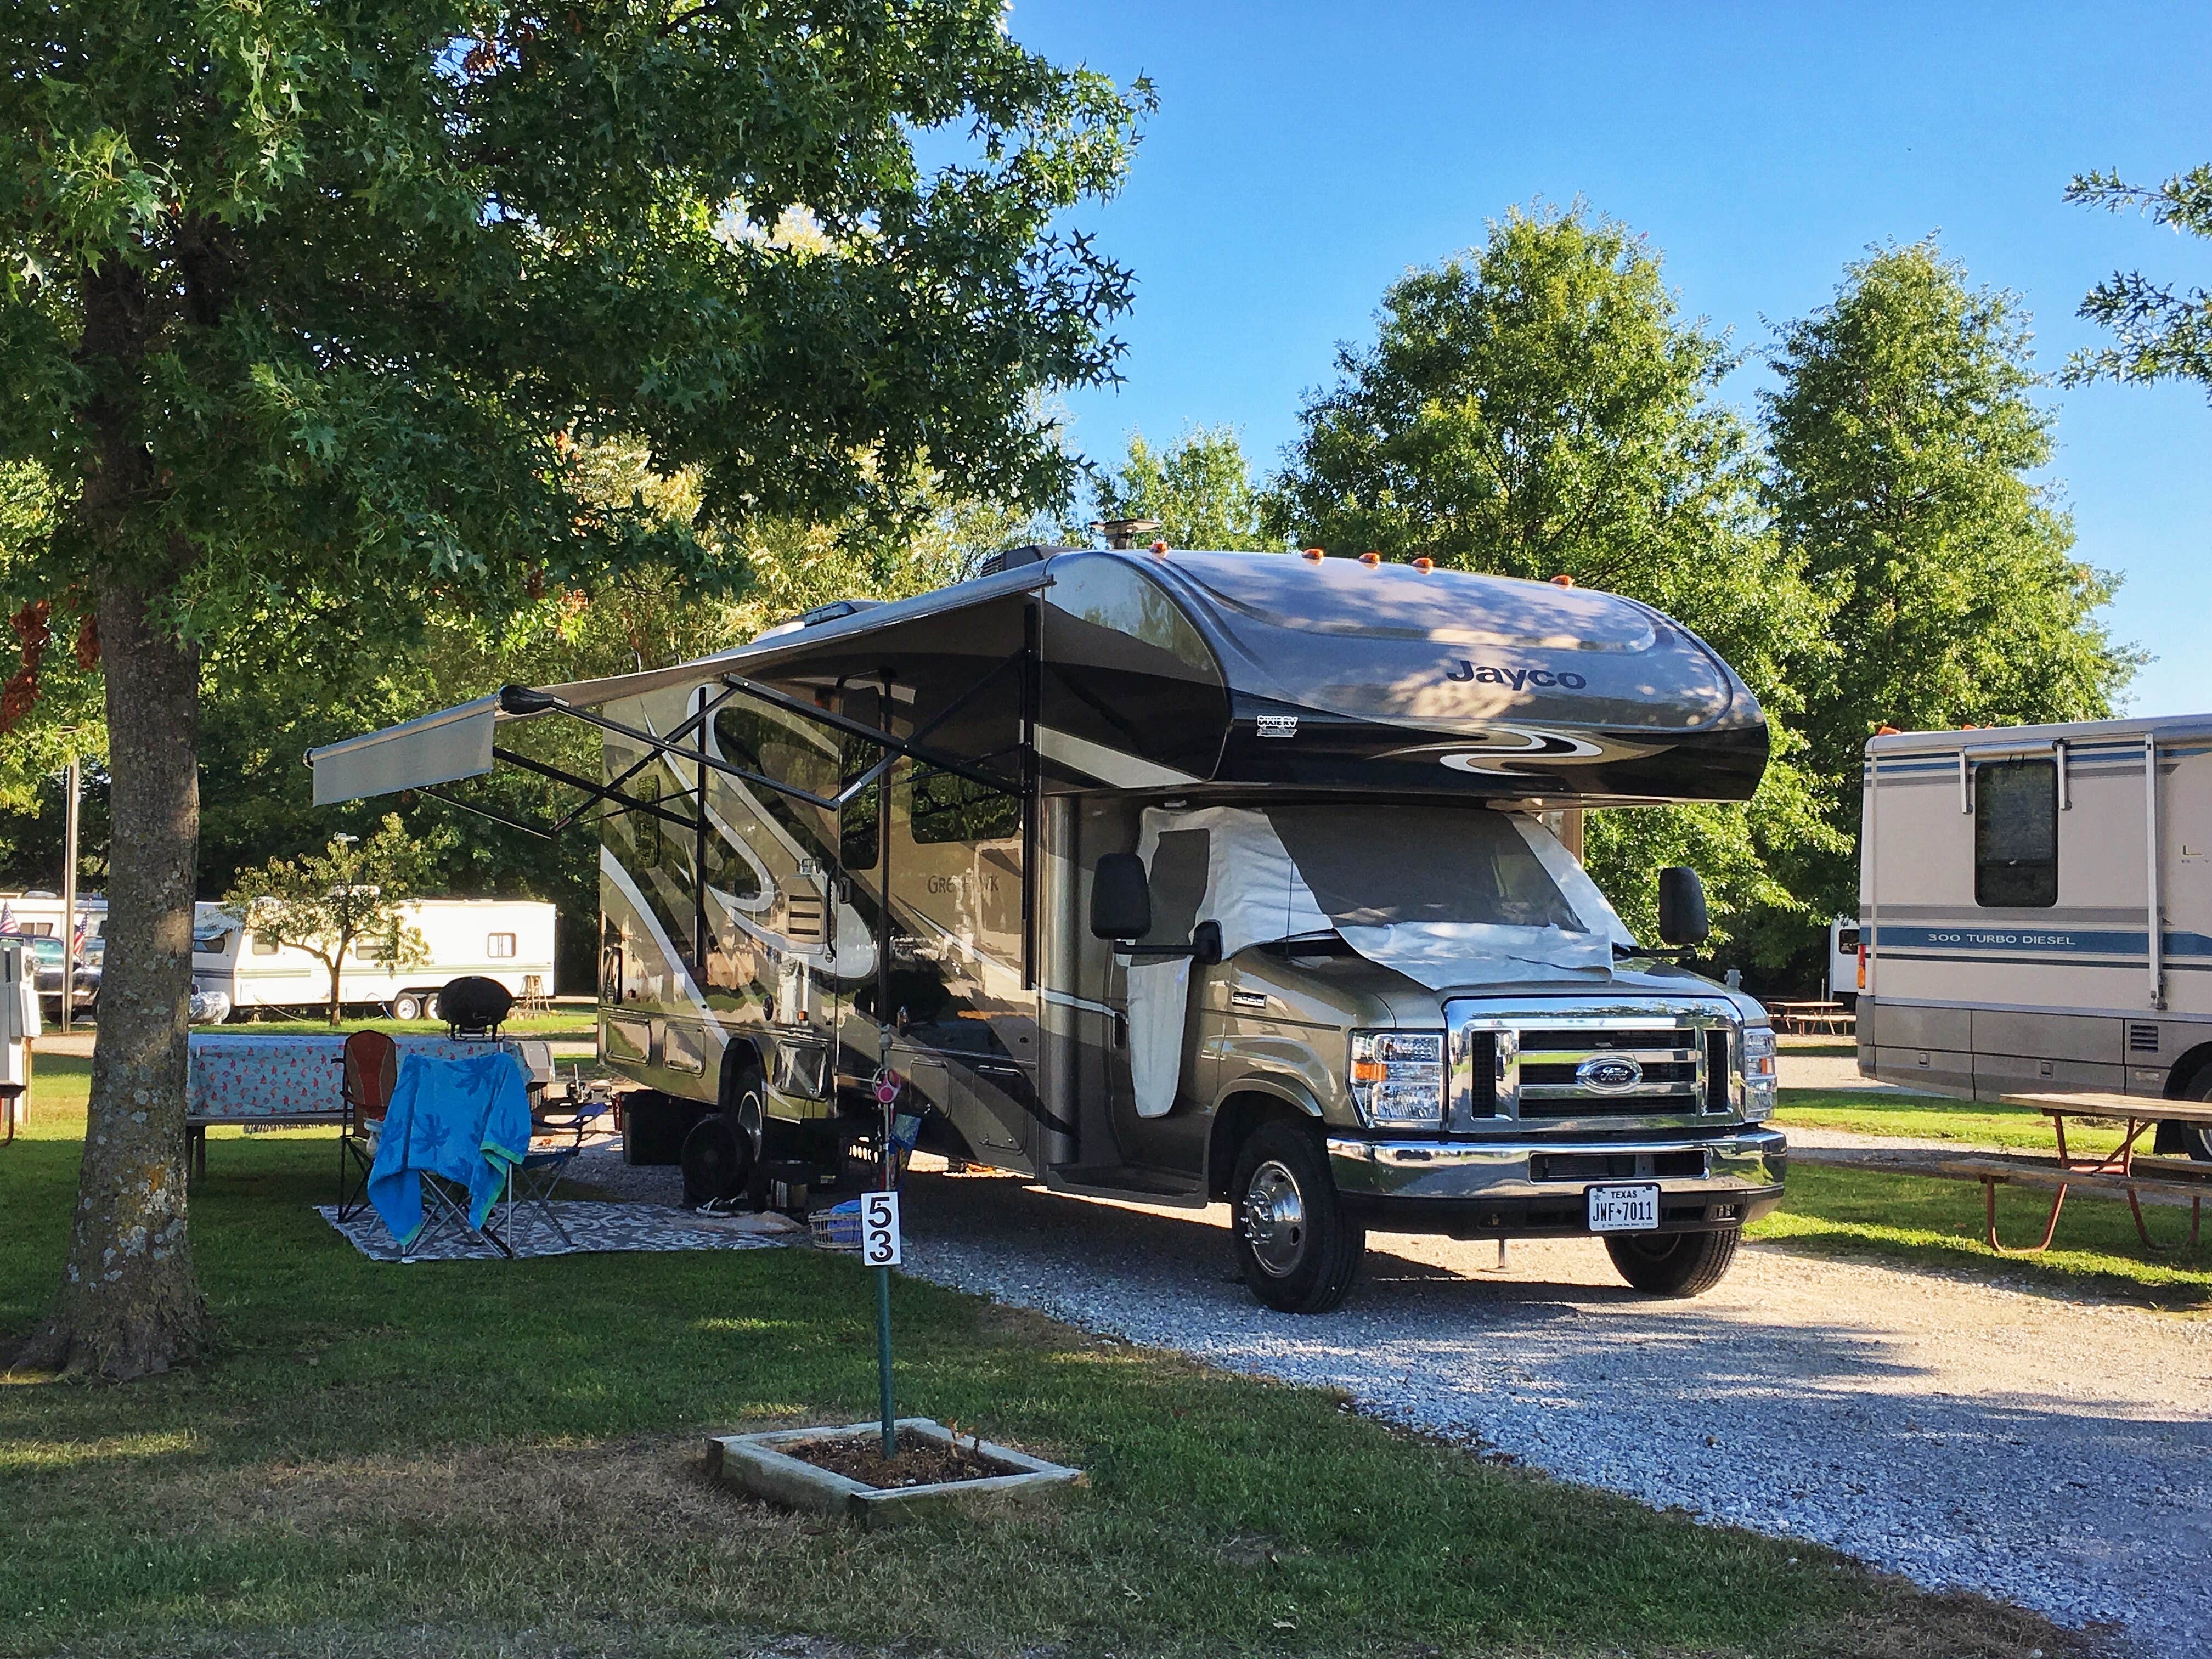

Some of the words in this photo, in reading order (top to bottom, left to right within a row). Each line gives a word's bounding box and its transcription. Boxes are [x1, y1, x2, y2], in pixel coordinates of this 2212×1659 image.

[1446, 660, 1587, 691] Jayco
[1283, 718, 1296, 726] RV
[1928, 934, 1961, 942] 300
[1966, 934, 2017, 944] TURBO
[2022, 936, 2076, 945] DIESEL
[1600, 1066, 1628, 1081] Ford
[1611, 1190, 1637, 1199] TEXAS
[1622, 1201, 1653, 1221] 7011
[868, 1196, 894, 1262] 53
